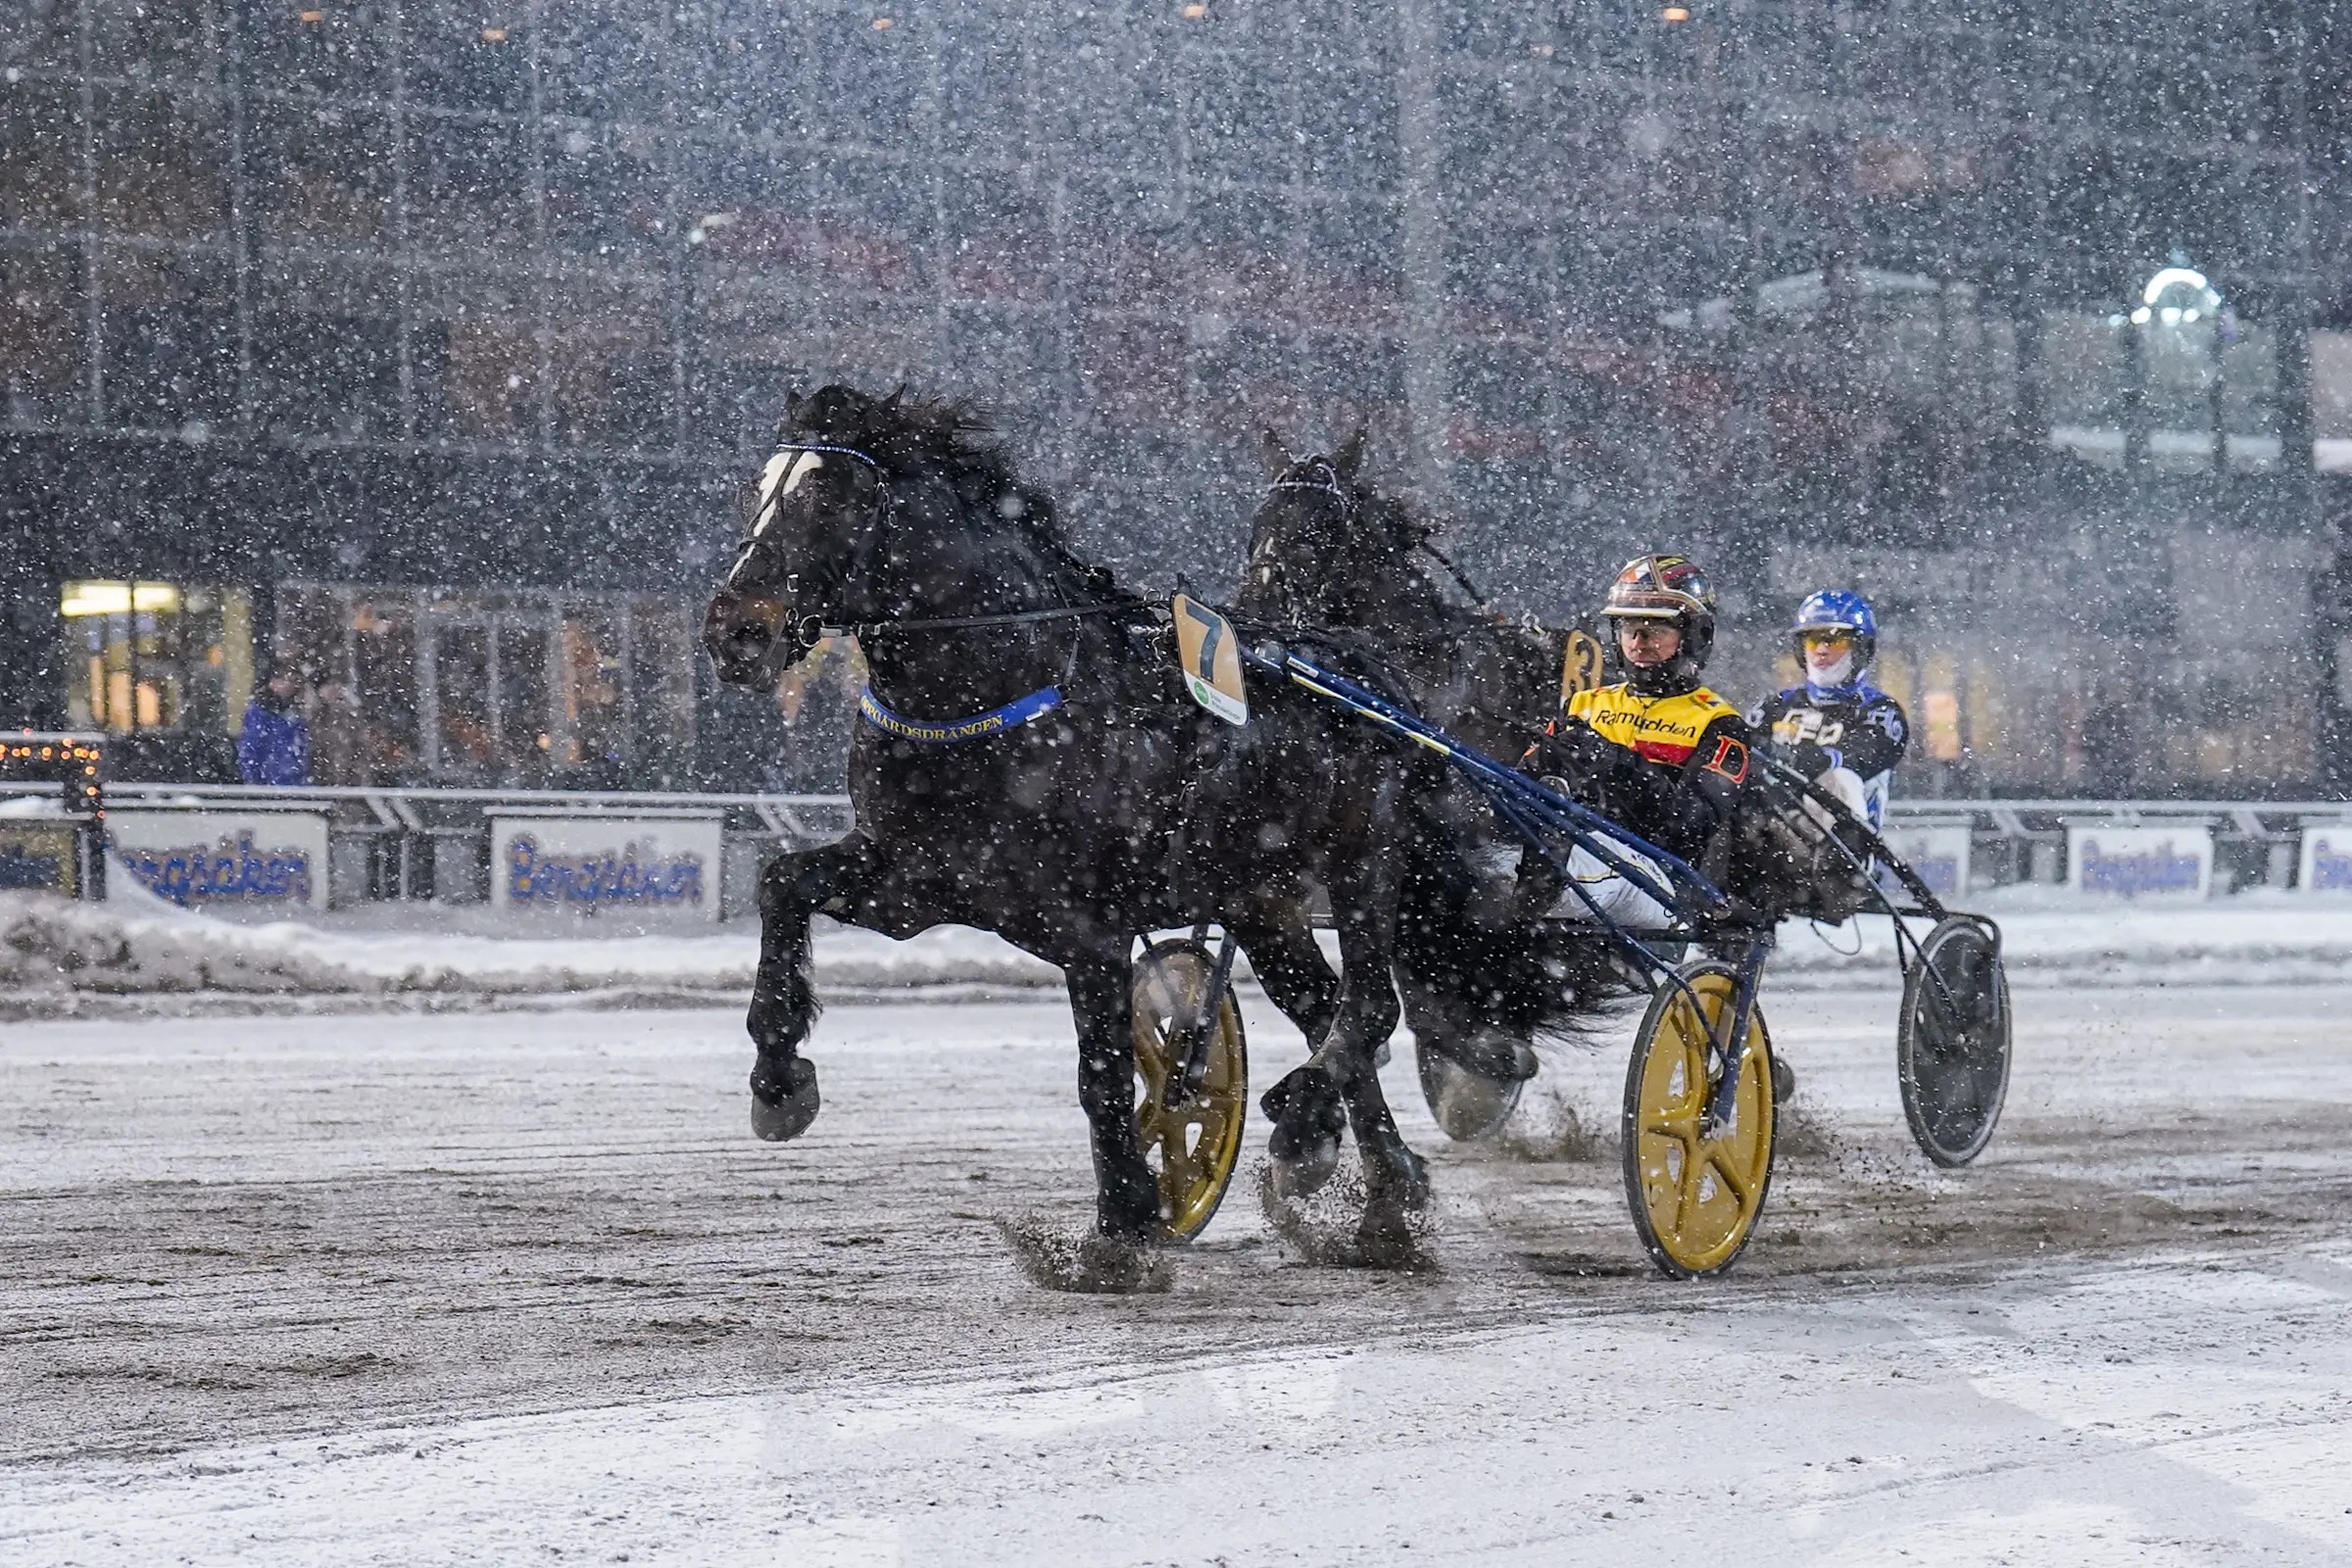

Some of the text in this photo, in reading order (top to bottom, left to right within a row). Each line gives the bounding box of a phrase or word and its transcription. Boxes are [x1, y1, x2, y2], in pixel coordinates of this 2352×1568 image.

[1184, 598, 1223, 685] 7
[1594, 710, 1696, 739] Ramudden
[1702, 735, 1749, 785] D
